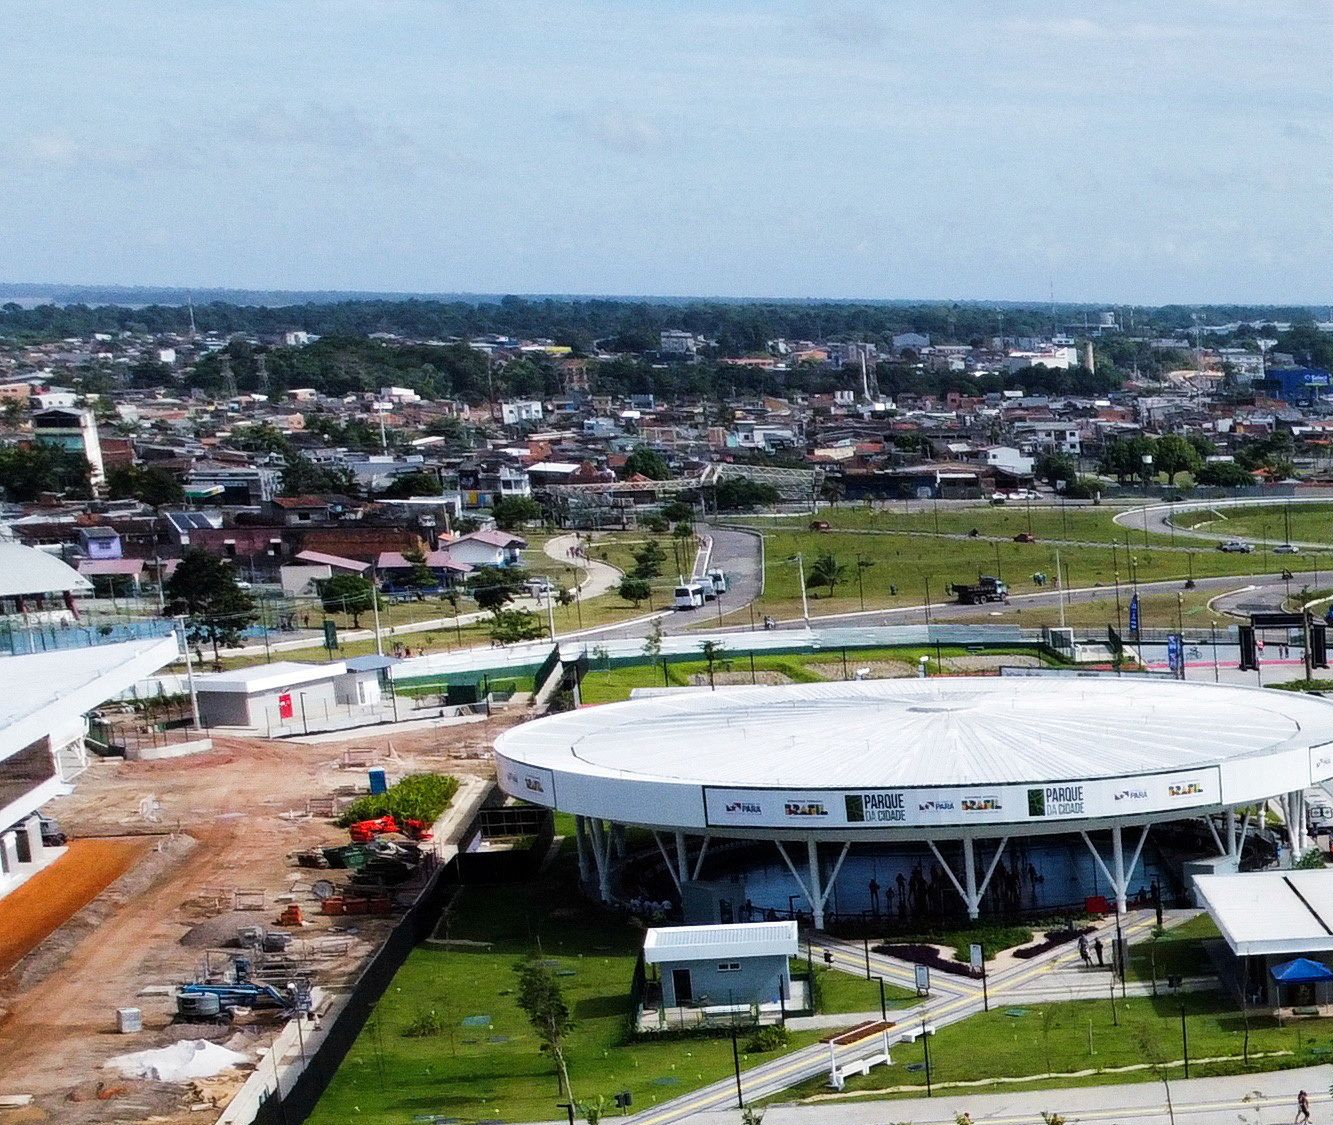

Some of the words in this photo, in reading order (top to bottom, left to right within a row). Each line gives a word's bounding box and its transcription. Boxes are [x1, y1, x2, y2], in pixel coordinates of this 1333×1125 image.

[1046, 786, 1084, 803] PARQUE
[863, 794, 905, 810] PARQUE
[1058, 802, 1085, 815] CIDADE
[784, 803, 829, 816] BRASIL
[877, 810, 906, 822] CIDADE
